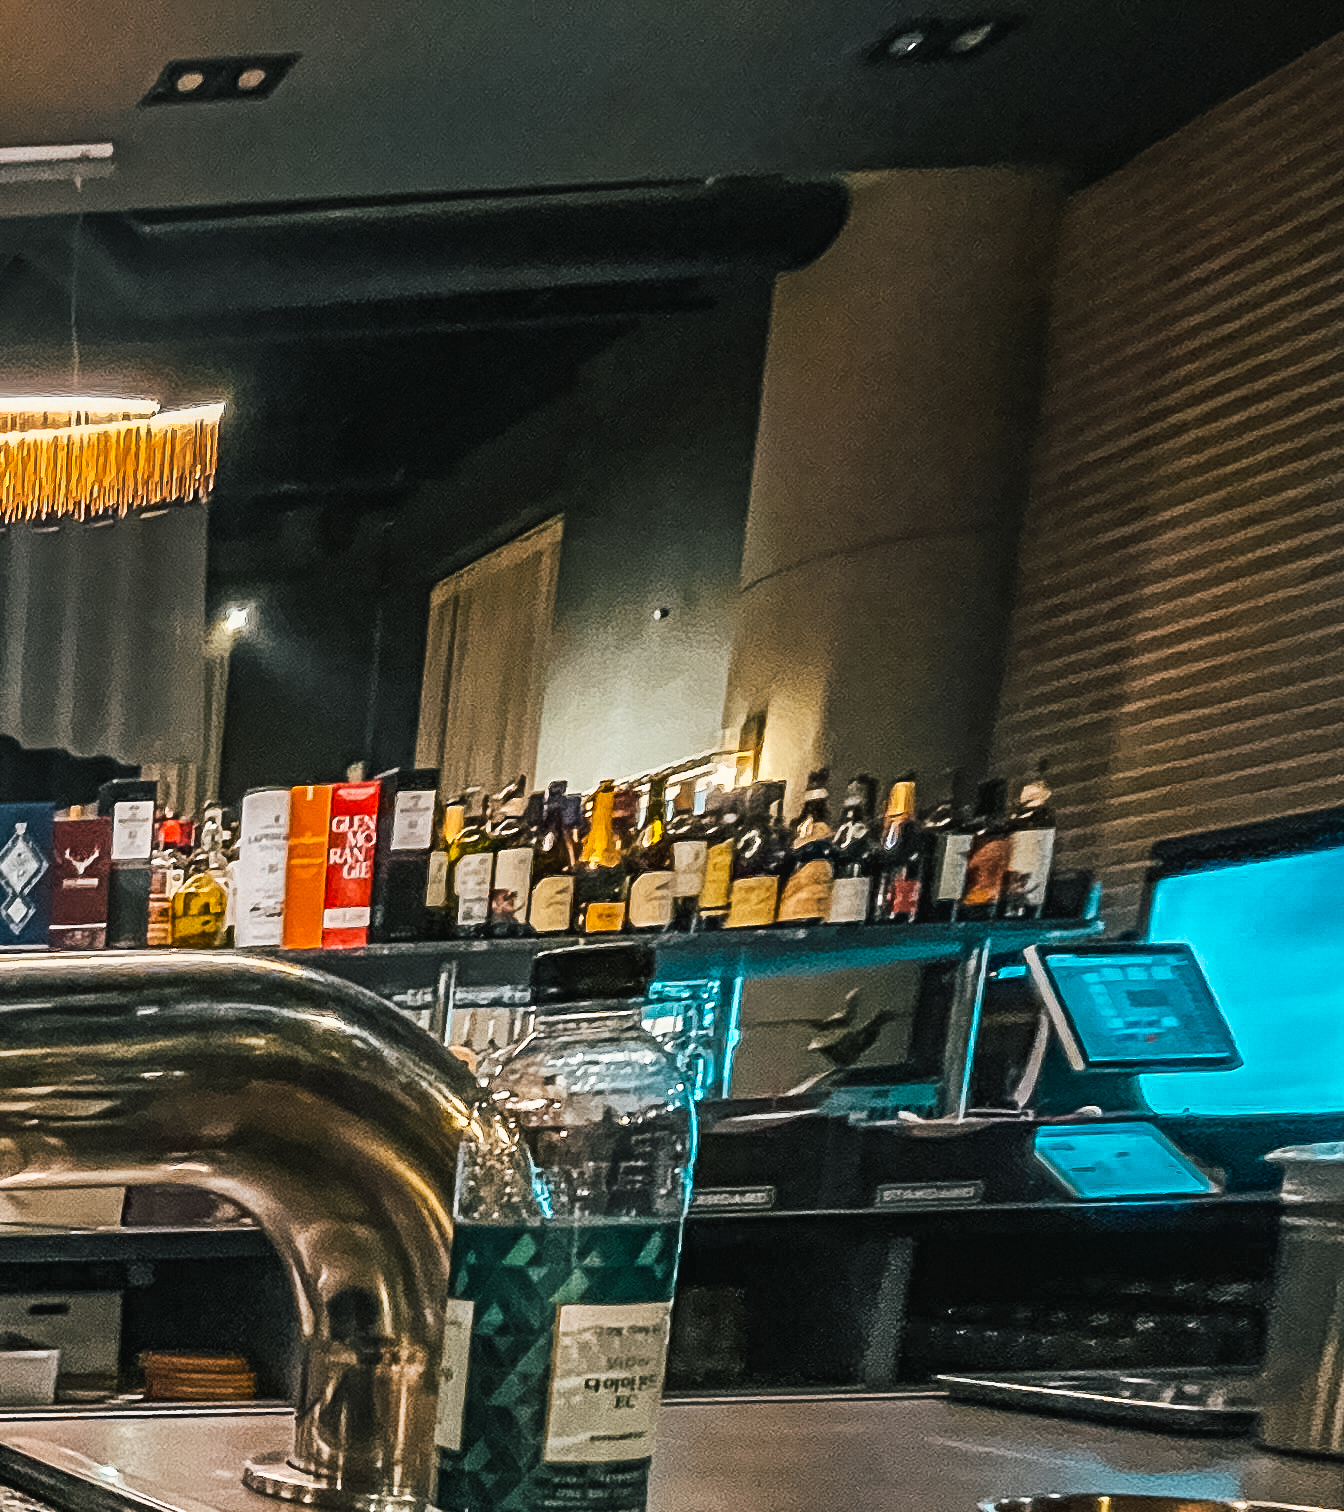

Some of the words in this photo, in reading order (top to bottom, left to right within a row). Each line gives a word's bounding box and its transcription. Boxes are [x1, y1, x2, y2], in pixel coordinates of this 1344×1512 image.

[332, 815, 377, 832] GLEN
[347, 830, 377, 847] MO
[329, 848, 365, 864] RAN
[342, 862, 371, 879] GIE
